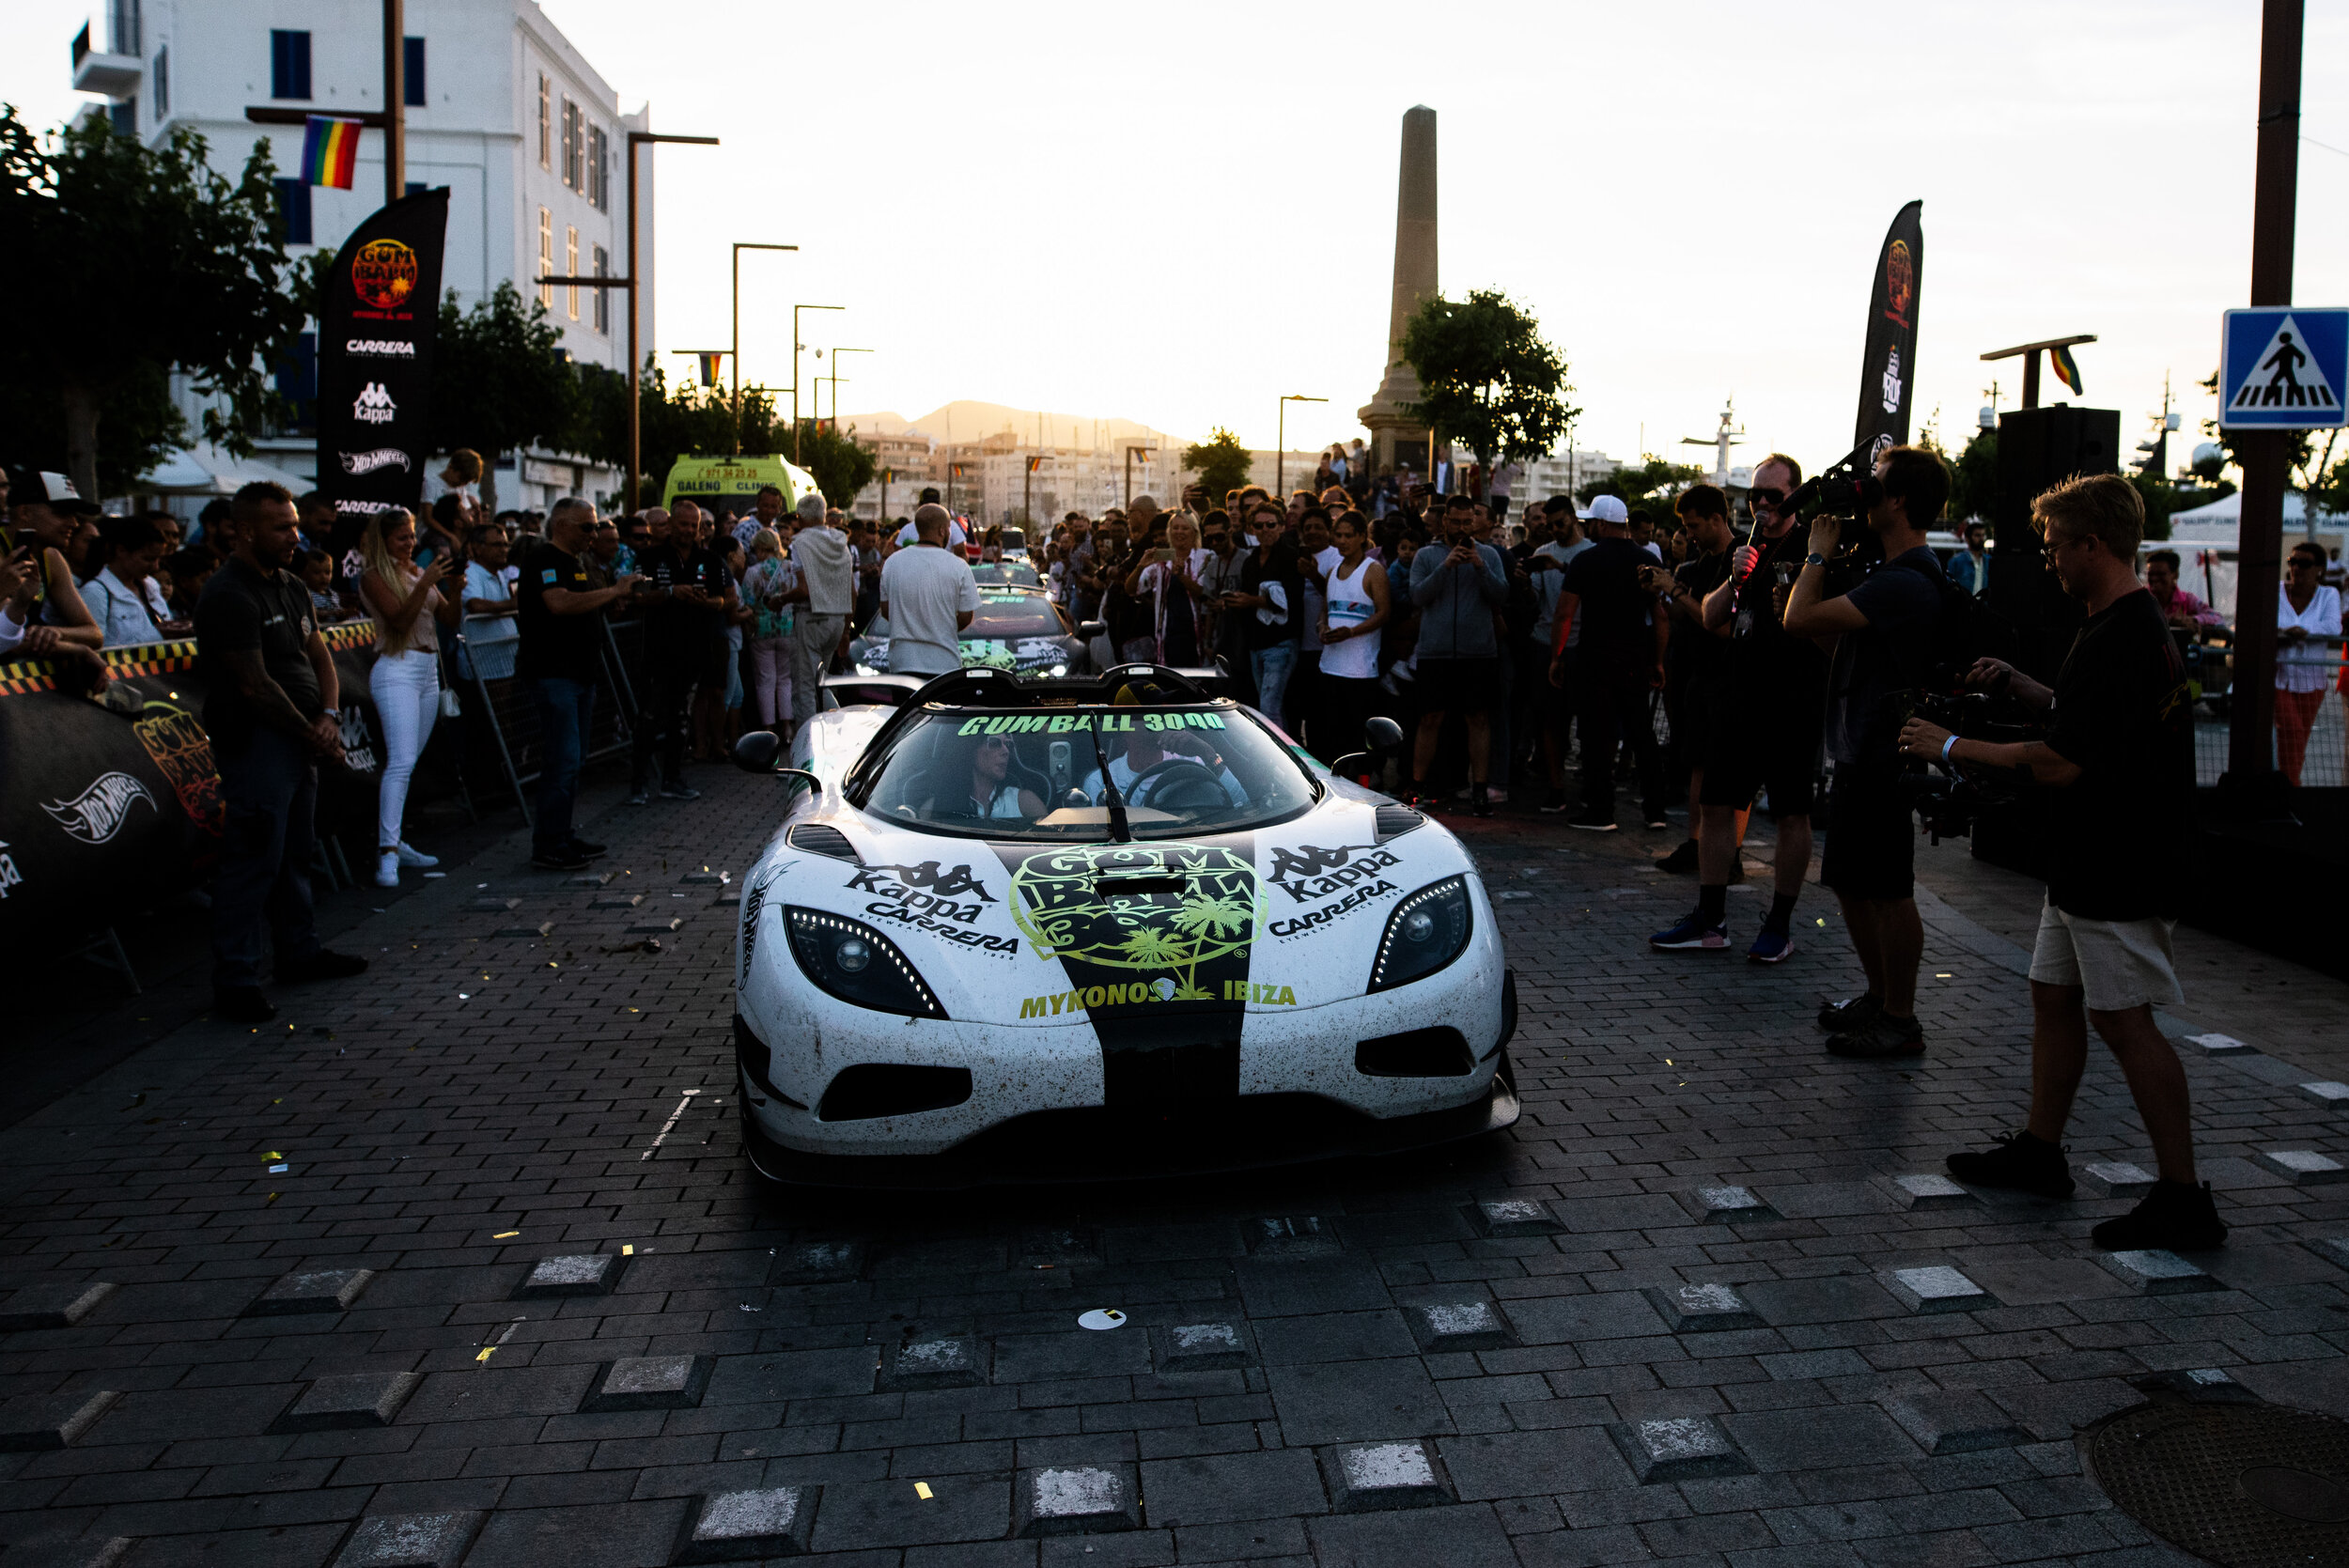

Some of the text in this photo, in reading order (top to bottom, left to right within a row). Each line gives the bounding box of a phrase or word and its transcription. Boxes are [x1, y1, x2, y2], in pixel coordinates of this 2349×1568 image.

[346, 339, 414, 354] CARRERA
[677, 481, 721, 491] GALENO
[957, 712, 1225, 737] GUMBALL 3000
[843, 870, 983, 924] Kappa
[1276, 850, 1404, 904] Kappa
[865, 902, 1019, 955] CARRERA
[1268, 879, 1398, 937] CARRERA
[1279, 889, 1405, 944] EYEWEAR SINCE 1956
[859, 913, 1014, 960] EYEWEAR SINCE 1956
[1223, 980, 1297, 1005] IBIZA
